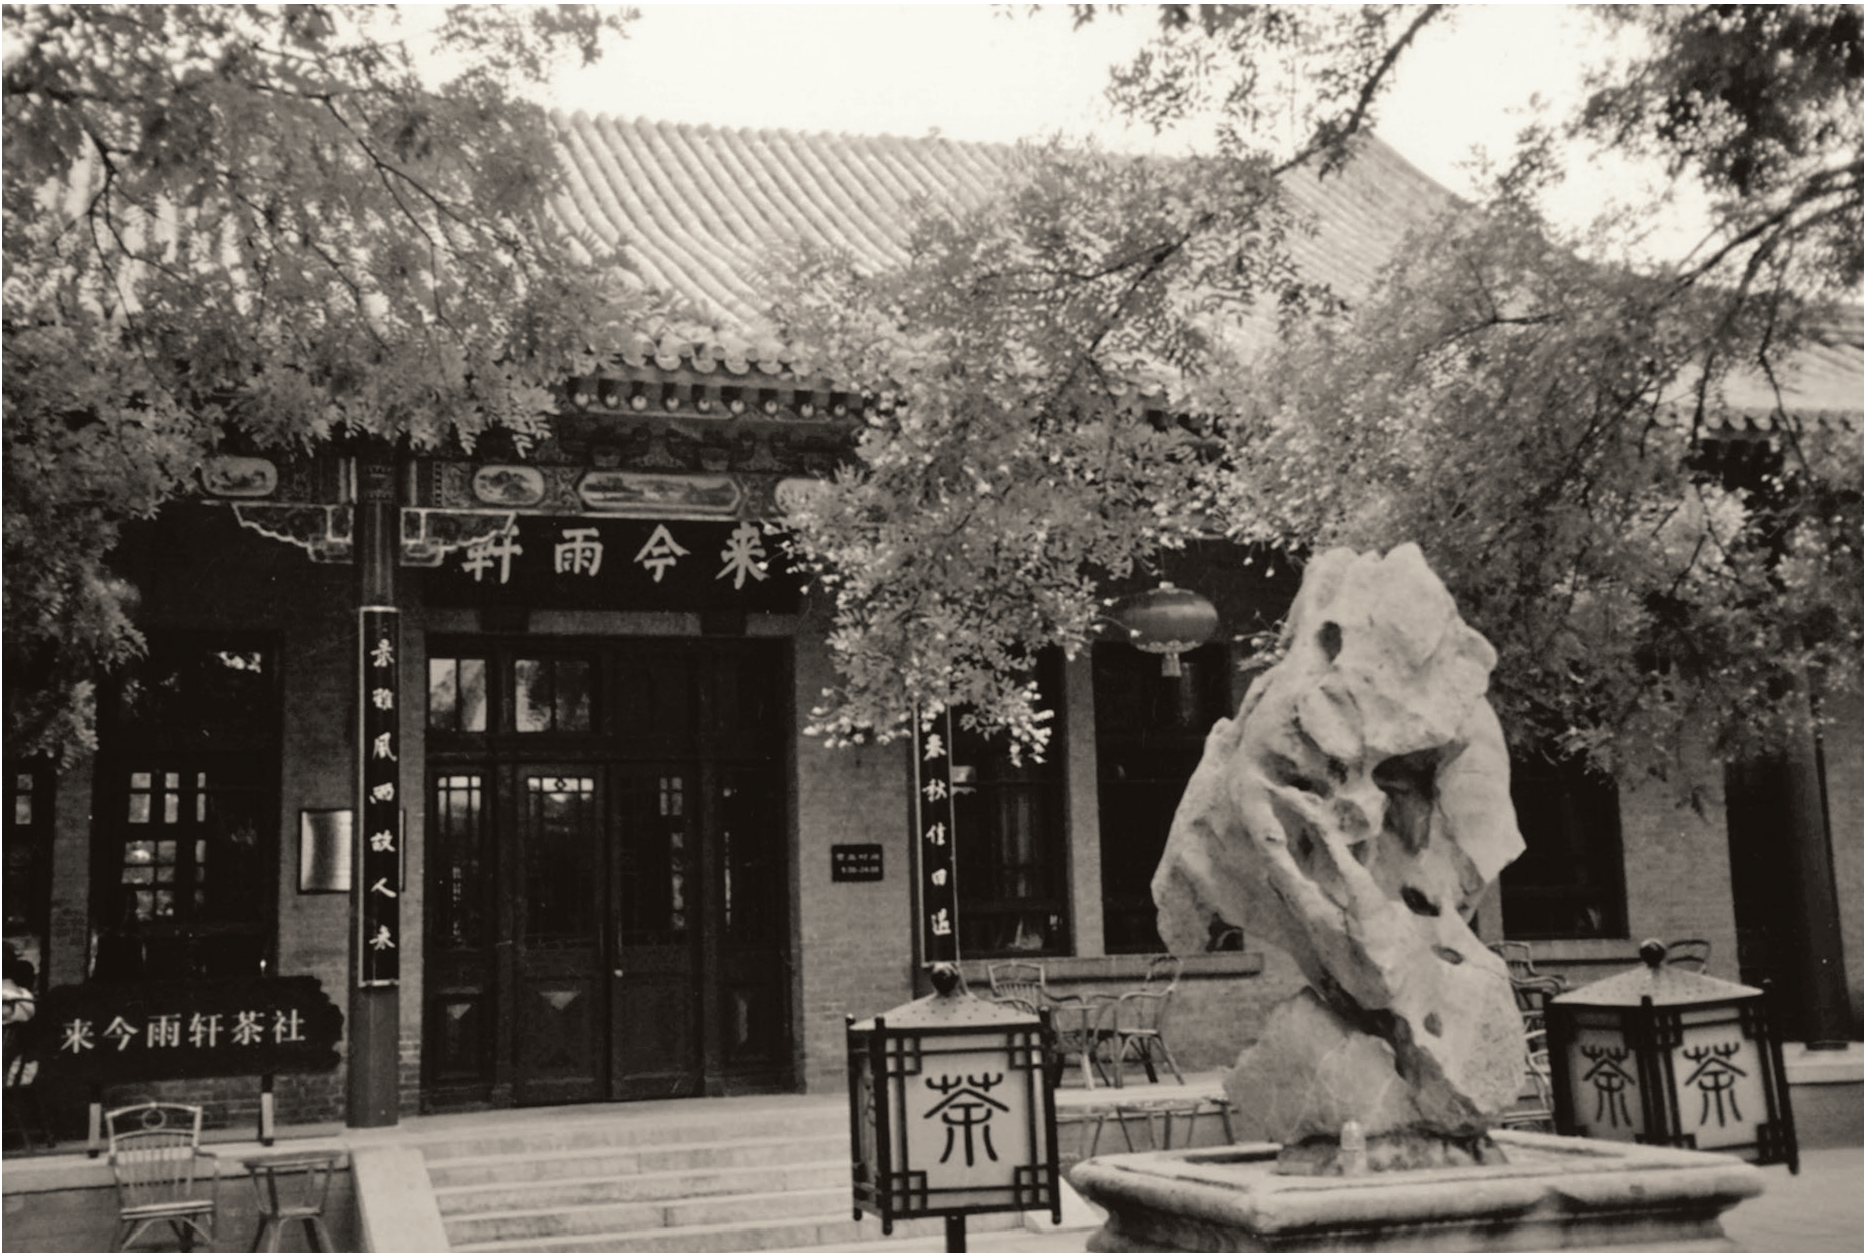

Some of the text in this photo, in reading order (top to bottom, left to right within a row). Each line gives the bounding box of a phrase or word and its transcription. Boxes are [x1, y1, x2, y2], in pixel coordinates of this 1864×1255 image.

[61, 1008, 306, 1053] 来今雨轩茶社
[923, 1072, 1010, 1167] 茶
[1683, 1042, 1748, 1128] 茶
